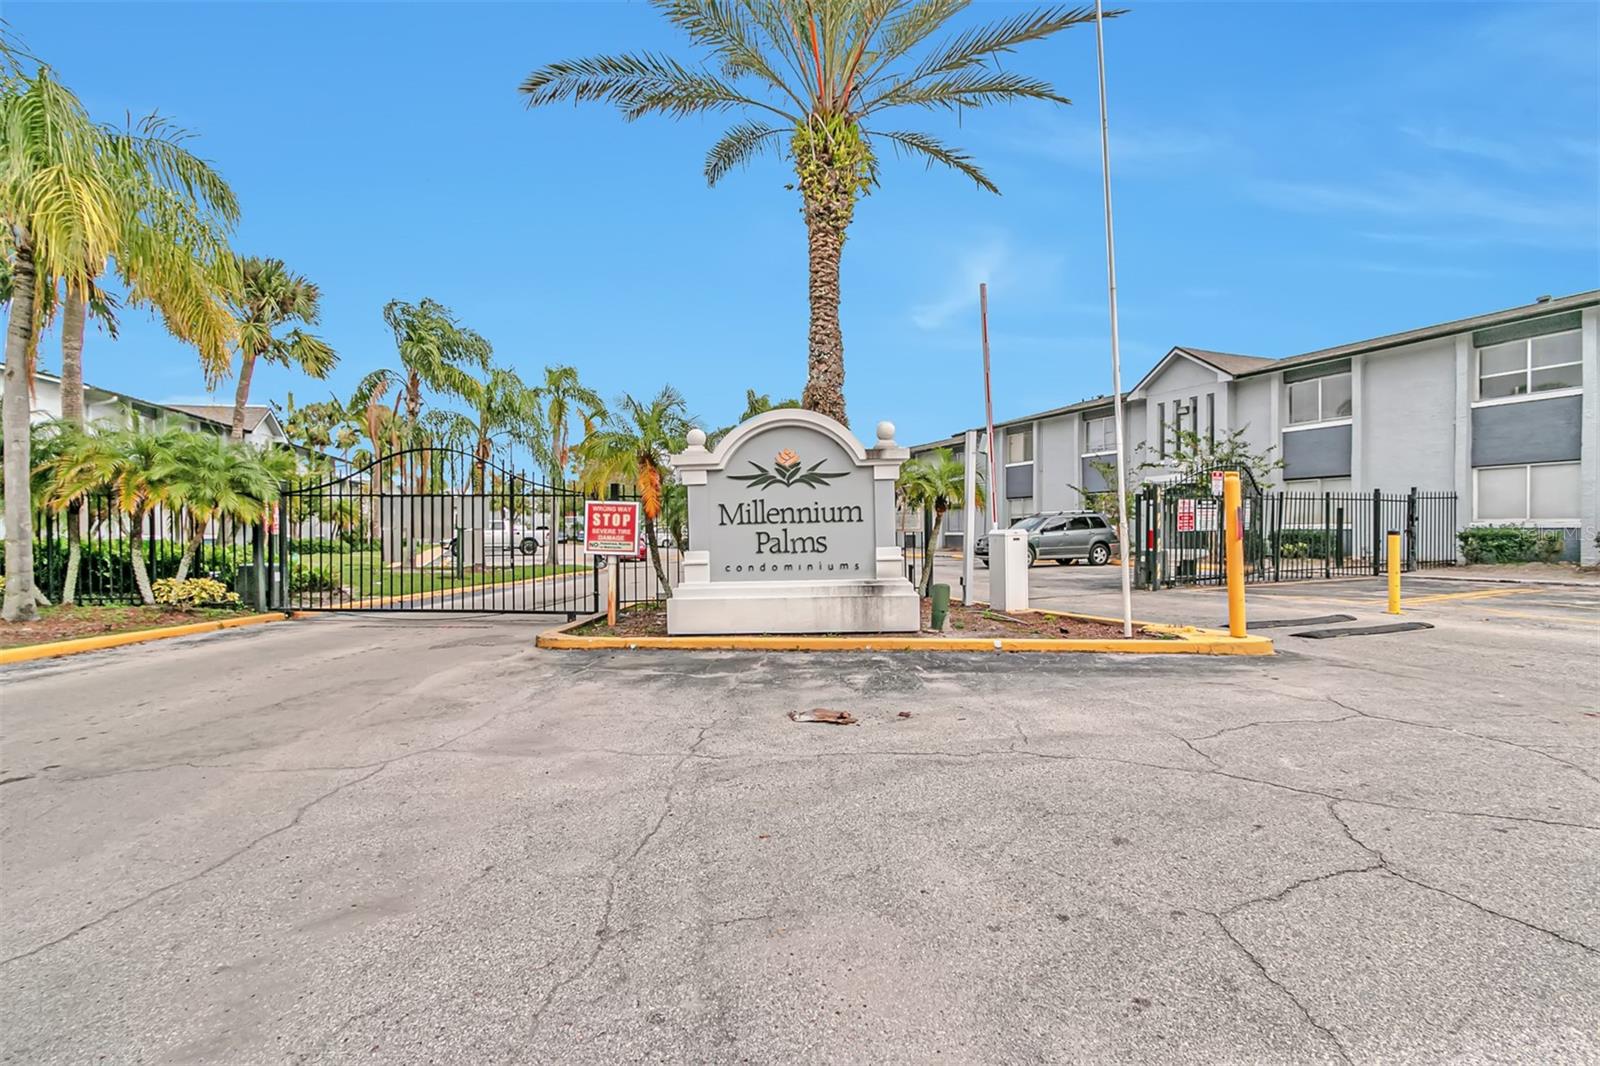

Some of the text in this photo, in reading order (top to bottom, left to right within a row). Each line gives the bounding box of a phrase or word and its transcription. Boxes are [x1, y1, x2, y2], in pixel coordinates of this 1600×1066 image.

[592, 513, 631, 527] STOP
[717, 499, 864, 526] Millennium
[755, 528, 828, 554] Palms
[724, 561, 861, 573] condominiums
